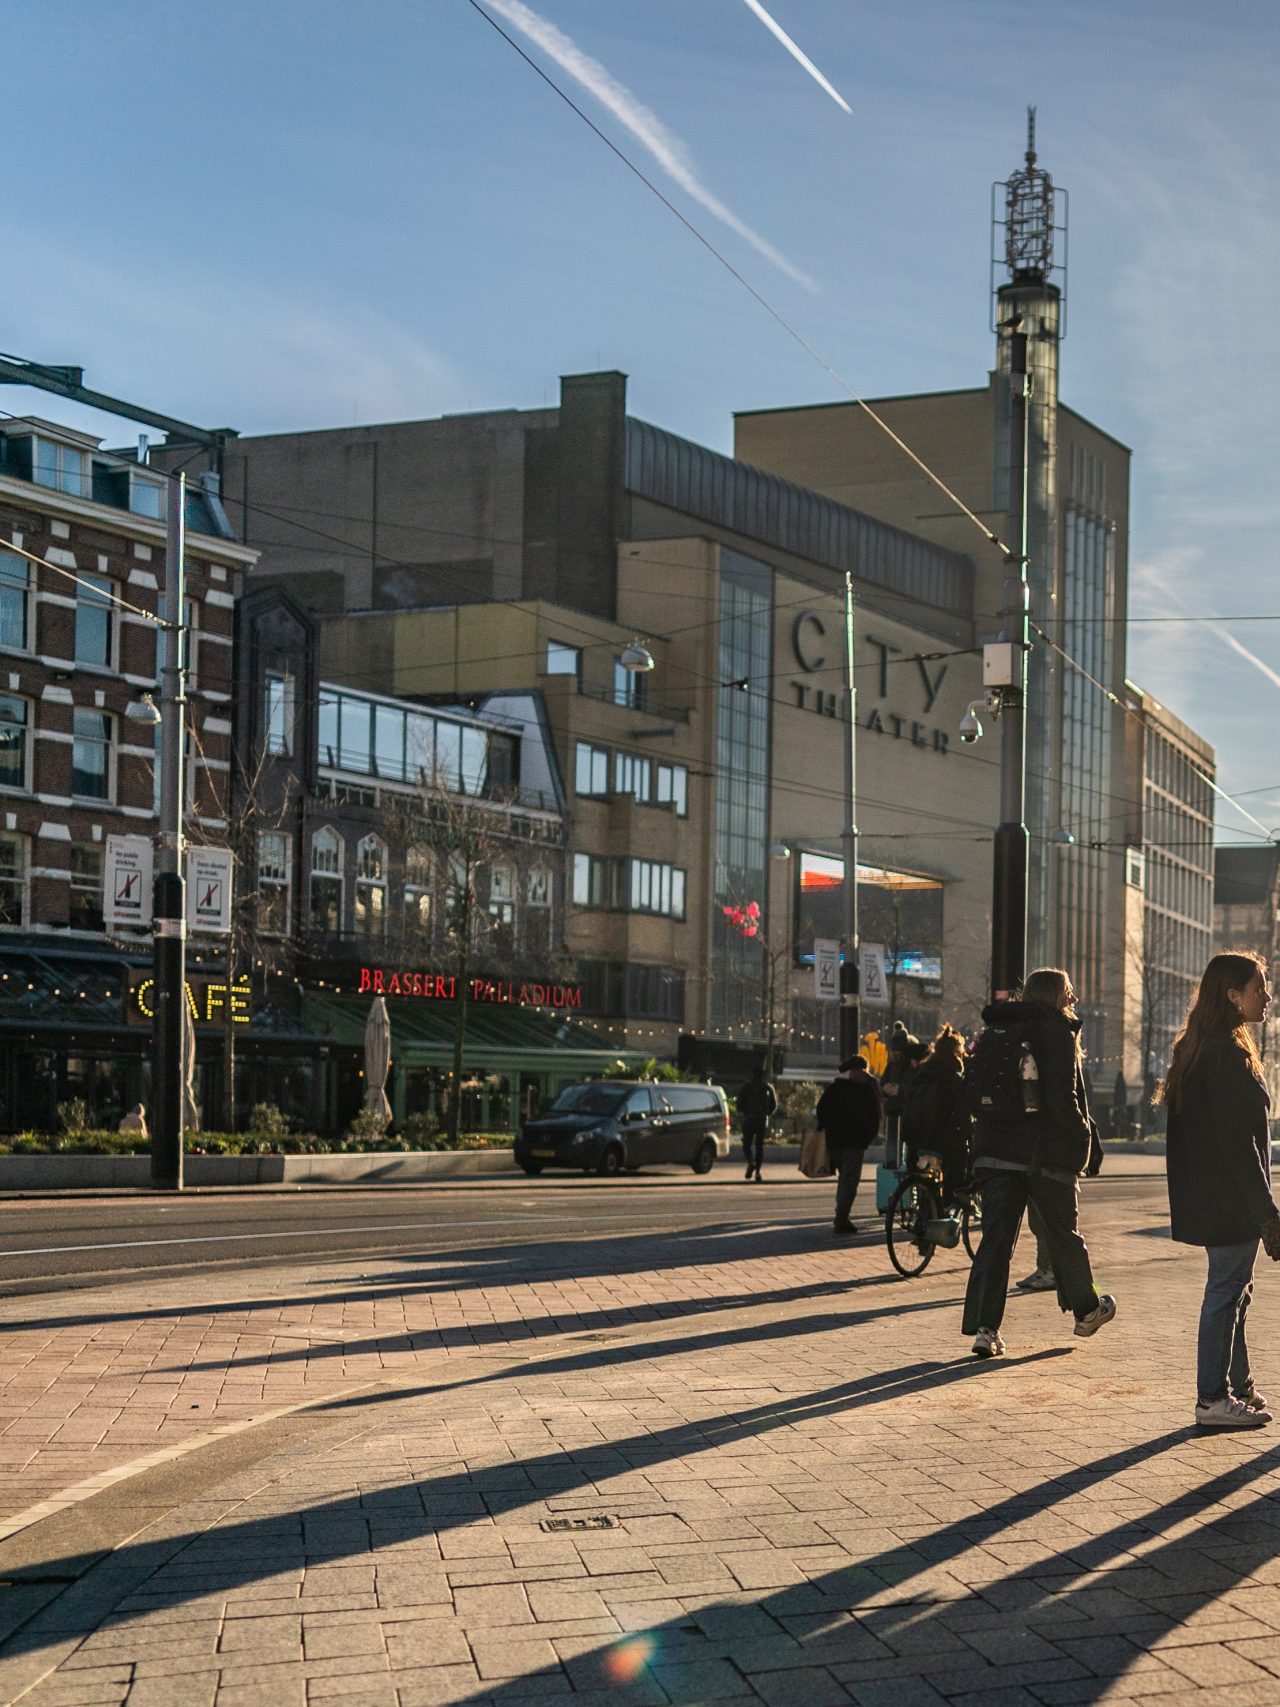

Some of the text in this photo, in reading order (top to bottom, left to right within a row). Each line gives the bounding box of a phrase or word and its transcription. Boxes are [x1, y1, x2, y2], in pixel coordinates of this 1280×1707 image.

[792, 610, 949, 714] CTY
[791, 680, 951, 755] THATER
[360, 968, 583, 1009] BRASSERI PALLADIUM
